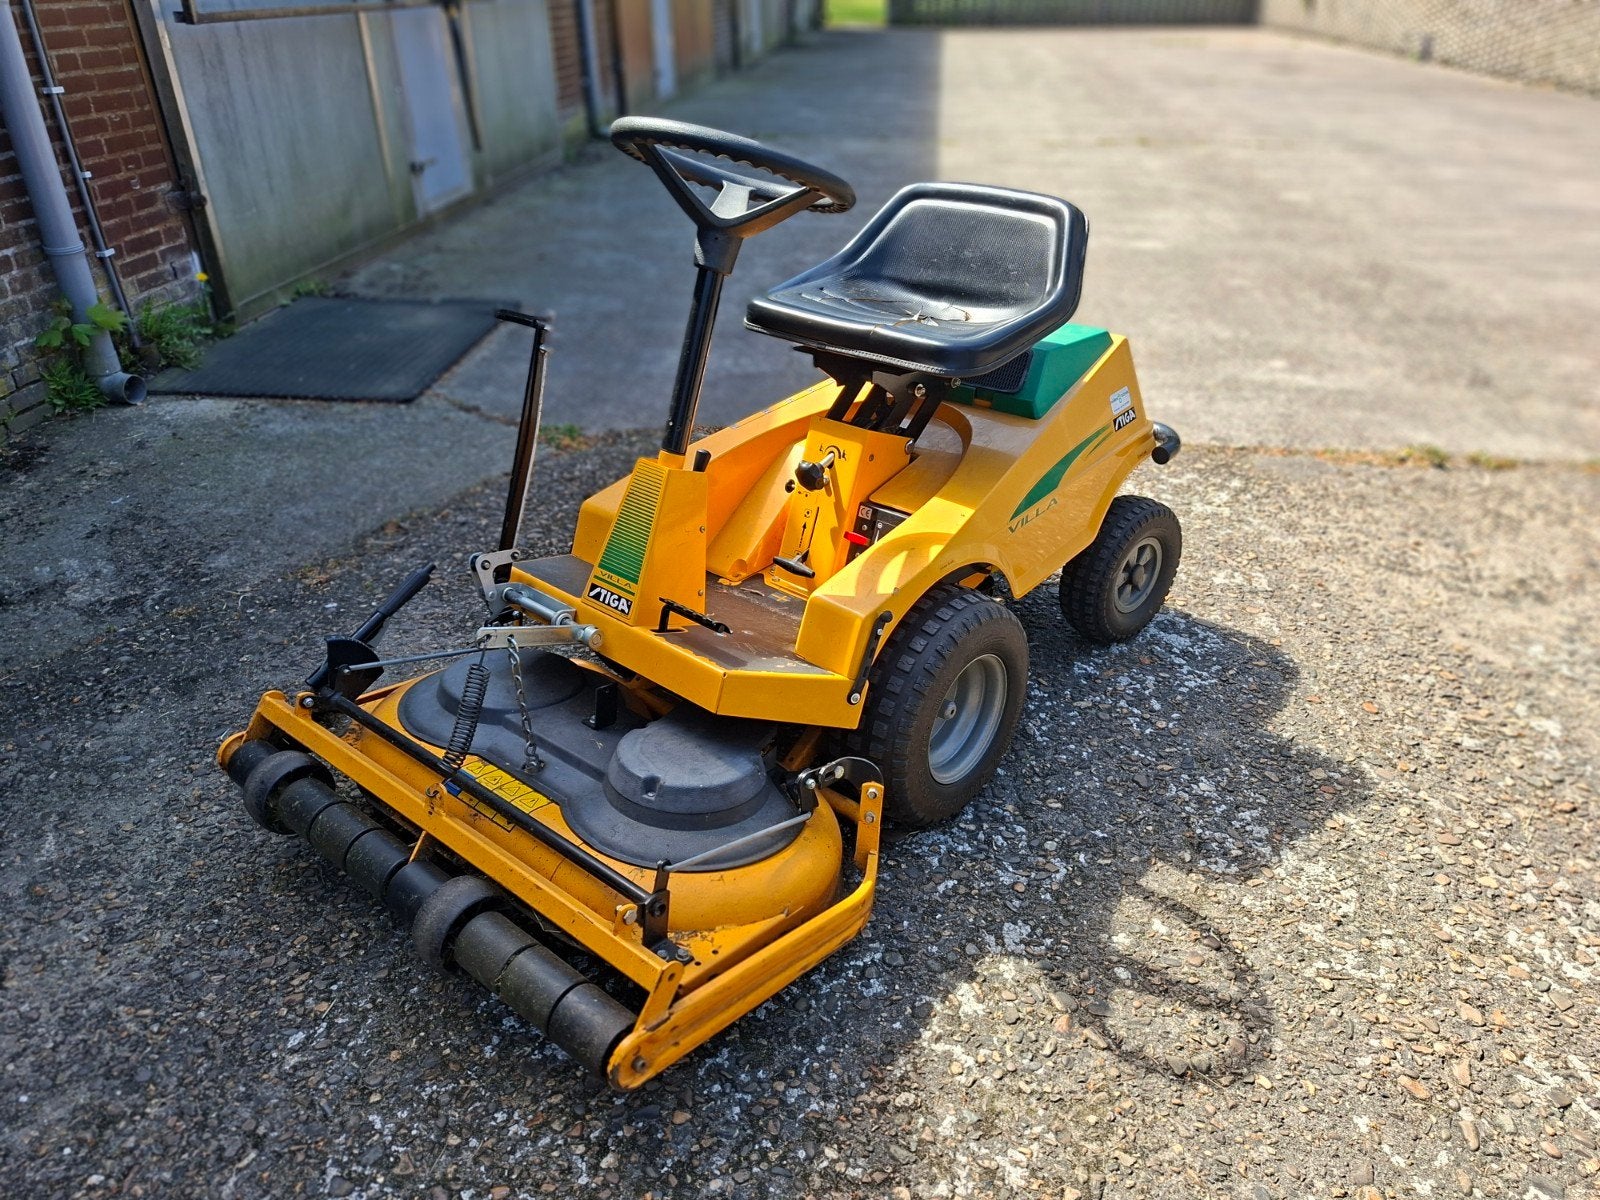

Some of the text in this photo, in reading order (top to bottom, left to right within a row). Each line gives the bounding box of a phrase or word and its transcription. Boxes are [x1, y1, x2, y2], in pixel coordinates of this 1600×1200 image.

[1115, 409, 1136, 430] STIGA
[1008, 497, 1058, 533] VILLA
[600, 570, 632, 589] VILLA
[589, 587, 629, 614] STIGA
